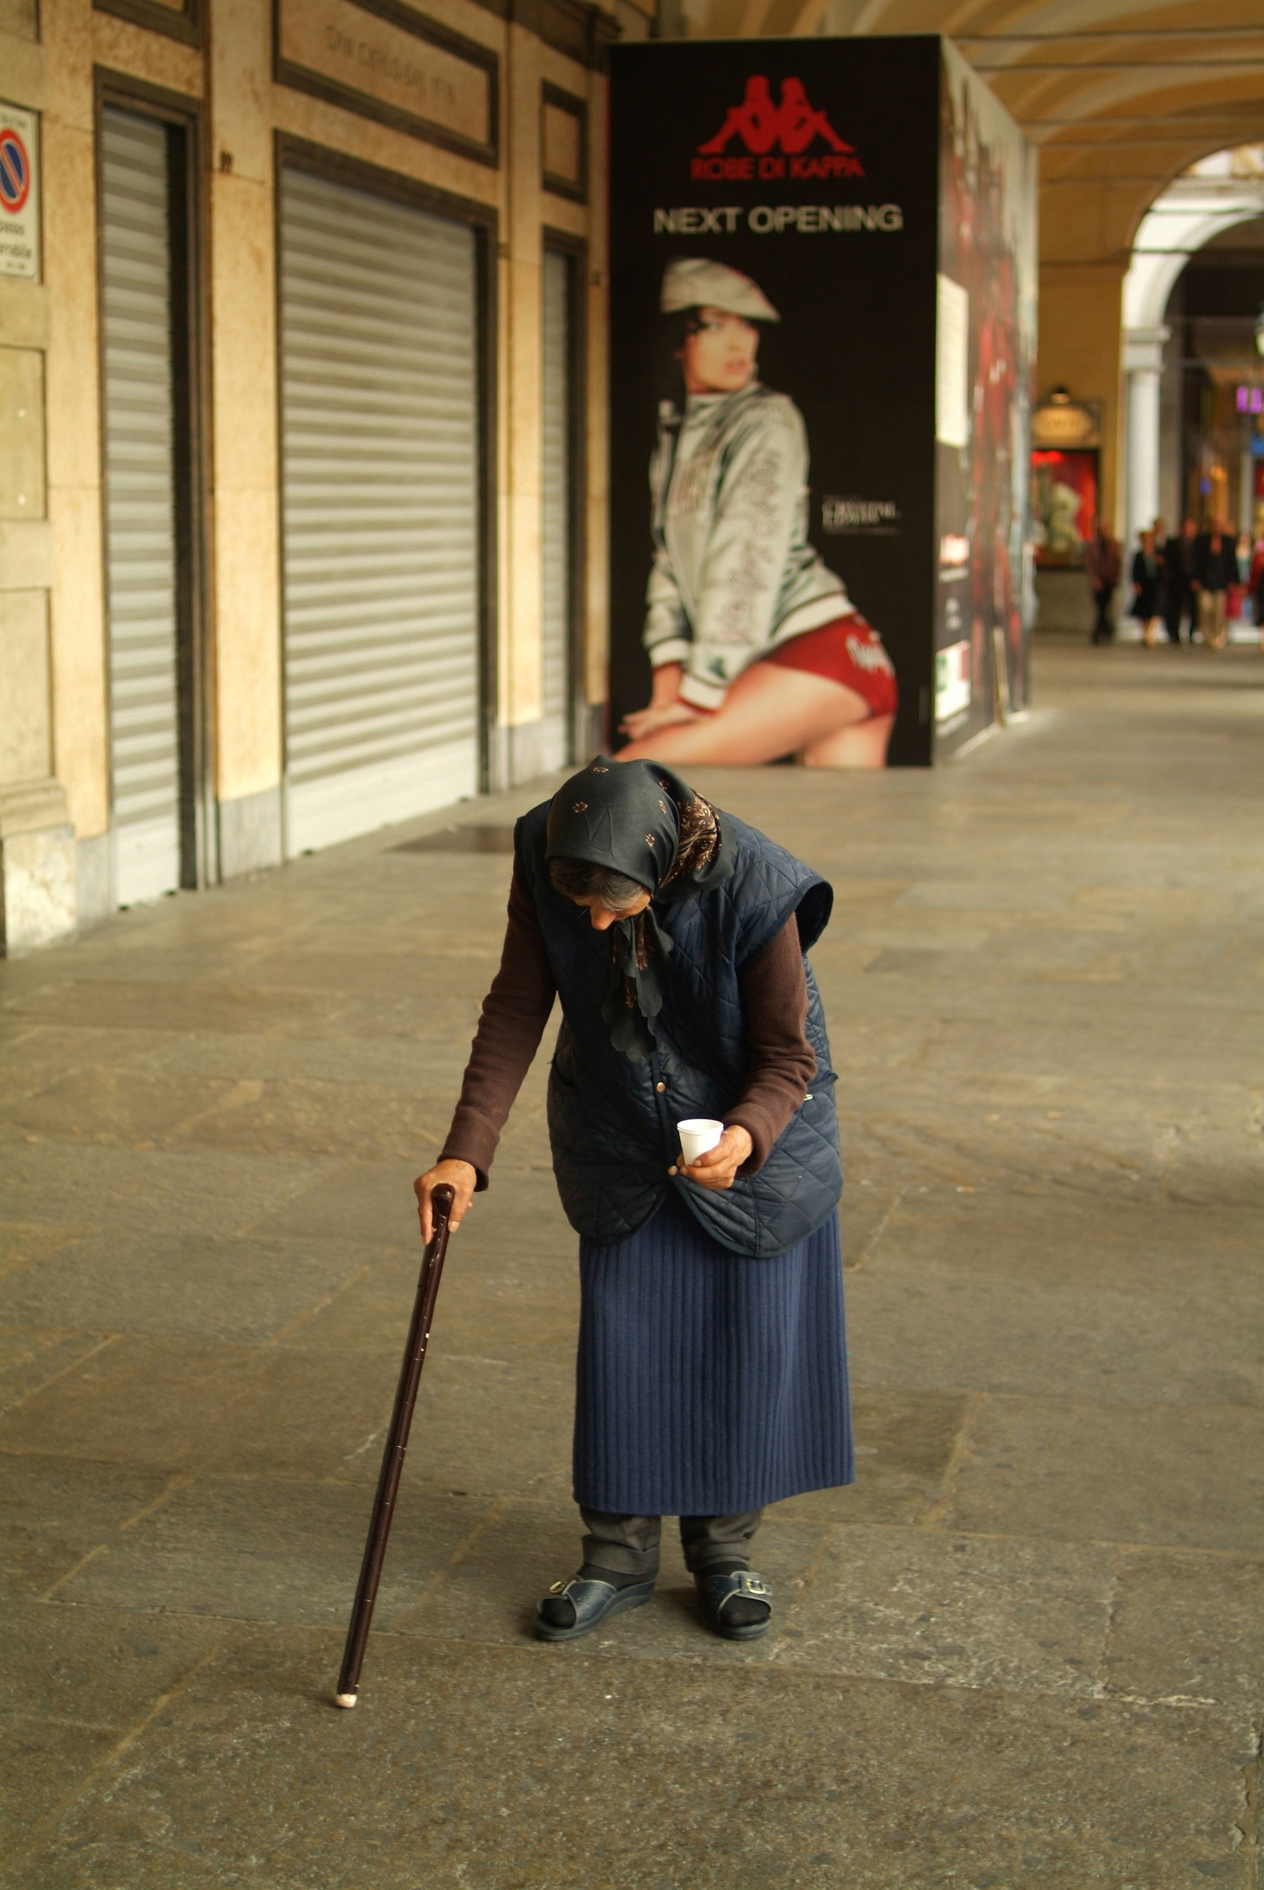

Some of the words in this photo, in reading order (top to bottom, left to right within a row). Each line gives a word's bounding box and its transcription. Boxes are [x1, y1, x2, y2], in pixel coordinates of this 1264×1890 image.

[691, 157, 754, 181] ROBE
[758, 156, 785, 180] DI
[789, 154, 866, 180] KAPPA
[653, 207, 742, 234] NEXT
[748, 203, 904, 233] OPENING
